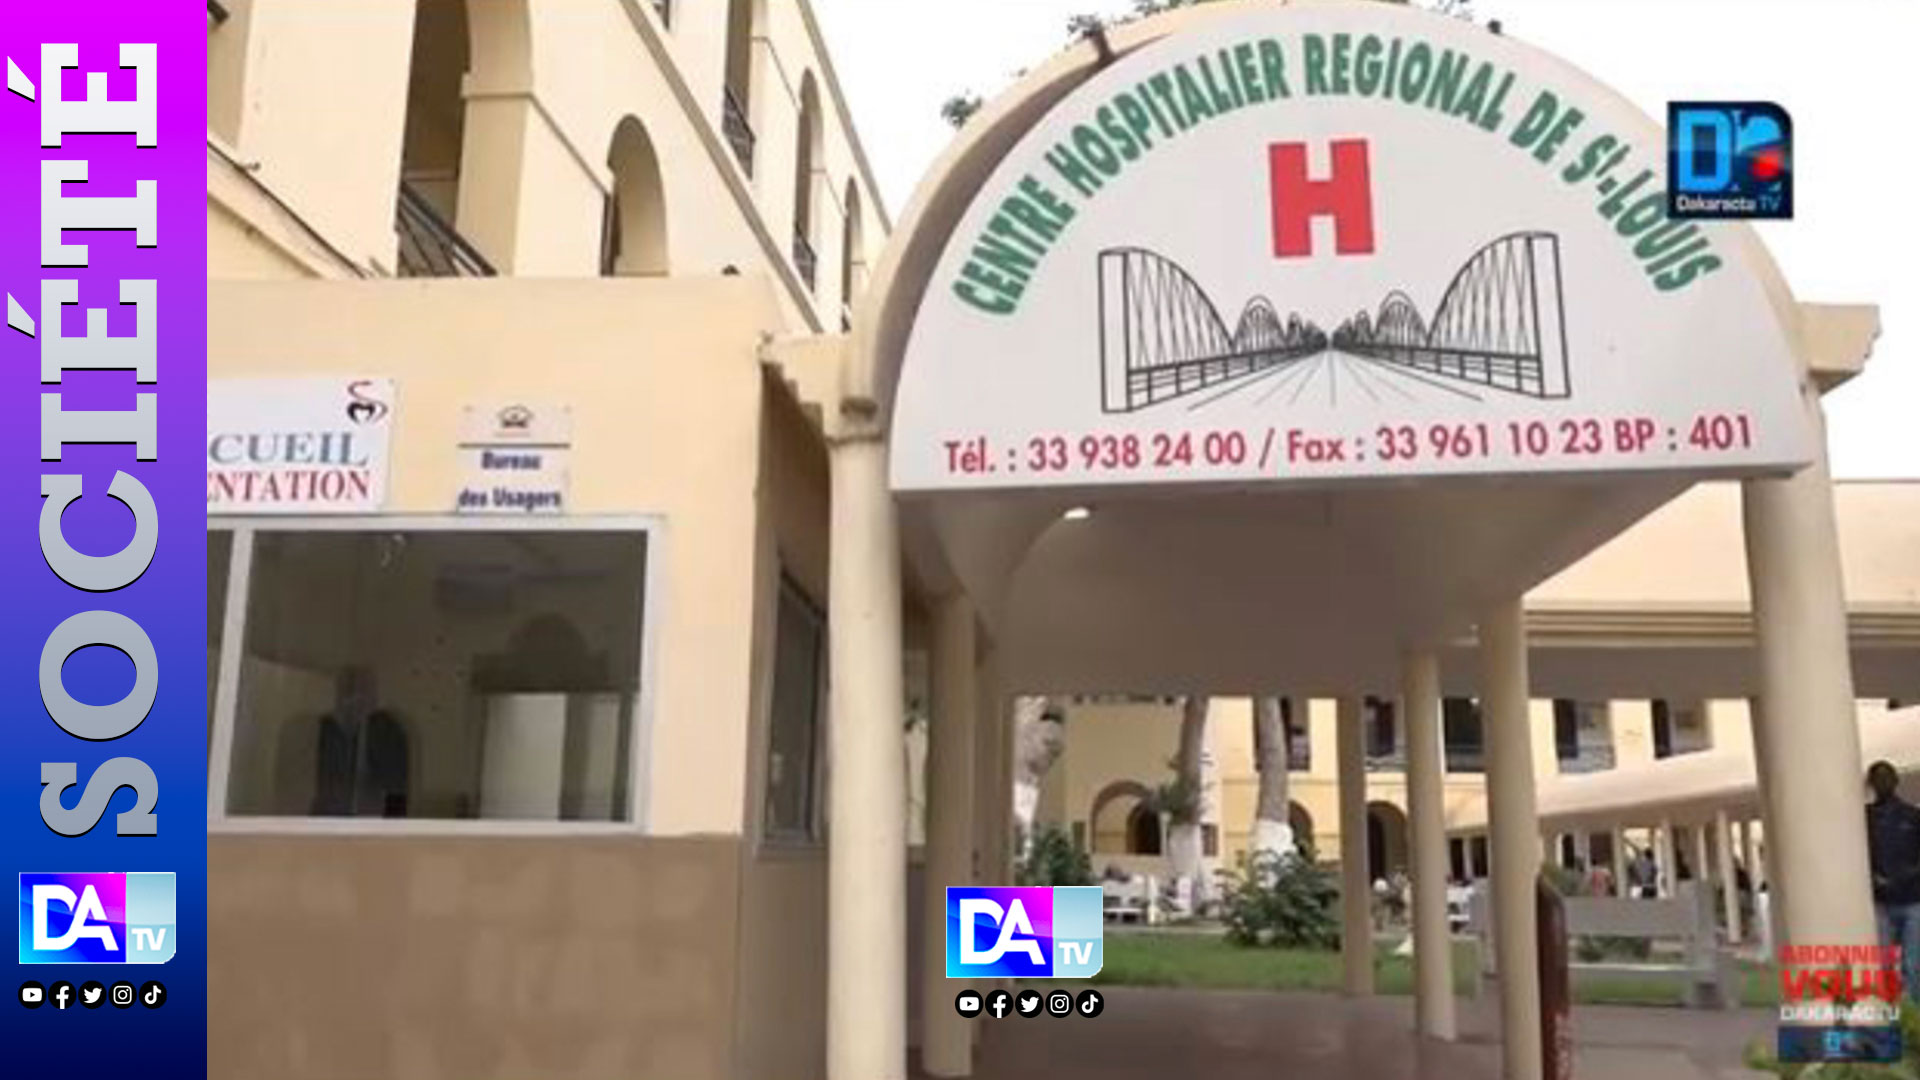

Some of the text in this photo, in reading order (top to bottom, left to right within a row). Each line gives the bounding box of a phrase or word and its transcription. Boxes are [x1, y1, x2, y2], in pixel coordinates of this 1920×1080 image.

[951, 175, 1078, 316] CENTRE
[1044, 38, 1291, 198] HOSPITALIER
[1302, 33, 1516, 132] REGIONAL
[1509, 90, 1584, 164] DE
[1268, 137, 1376, 259] H
[481, 450, 542, 470] Bureau
[943, 436, 996, 475] Tél.
[1028, 436, 1068, 471] 33
[1080, 435, 1141, 469] 938
[1152, 431, 1194, 468] 24
[1204, 430, 1246, 466] 00
[1287, 429, 1346, 464] Fax
[1376, 425, 1418, 460] 33
[1428, 423, 1490, 458] 961
[1508, 421, 1548, 457] 10
[1559, 419, 1603, 455] 23
[1613, 418, 1655, 453] BP
[1688, 415, 1753, 450] 401
[458, 486, 562, 512] des Usagers
